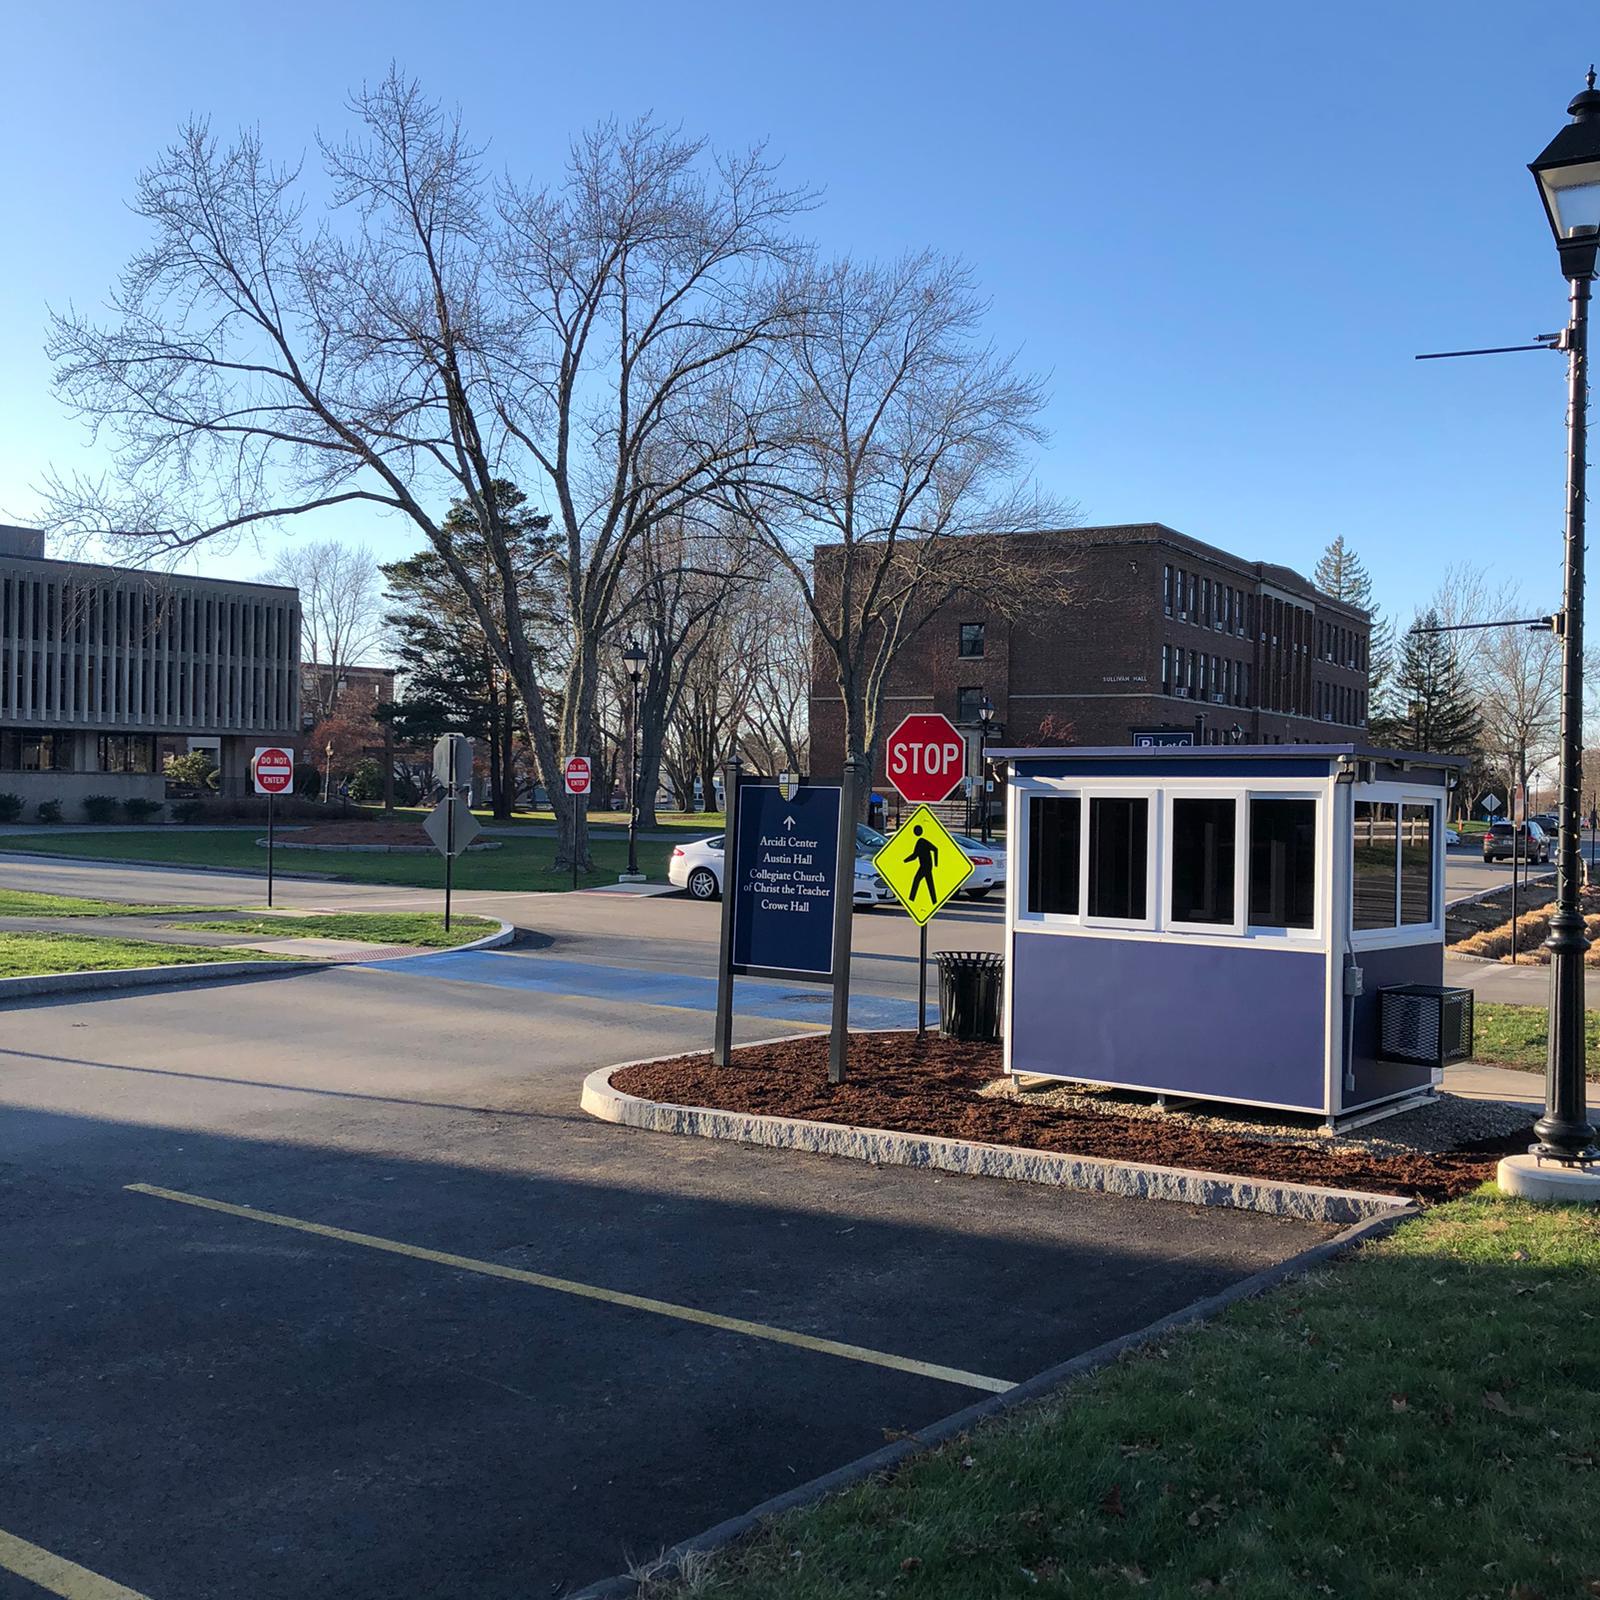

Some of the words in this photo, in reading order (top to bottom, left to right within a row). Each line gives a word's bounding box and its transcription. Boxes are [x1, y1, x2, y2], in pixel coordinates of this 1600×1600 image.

[261, 756, 271, 764] DO
[892, 743, 959, 775] STOP
[263, 776, 285, 784] ENTER
[760, 836, 786, 847] Arcidi
[788, 837, 818, 848] Center
[763, 853, 791, 864] Austin
[793, 854, 812, 865] Hall
[750, 868, 791, 882] Collegiate
[793, 871, 825, 882] Church
[744, 882, 753, 892] of
[753, 882, 780, 893] Christ
[782, 884, 795, 894] the
[796, 884, 830, 896] Teacher
[761, 899, 788, 910] Crowe
[790, 901, 809, 912] Hall
